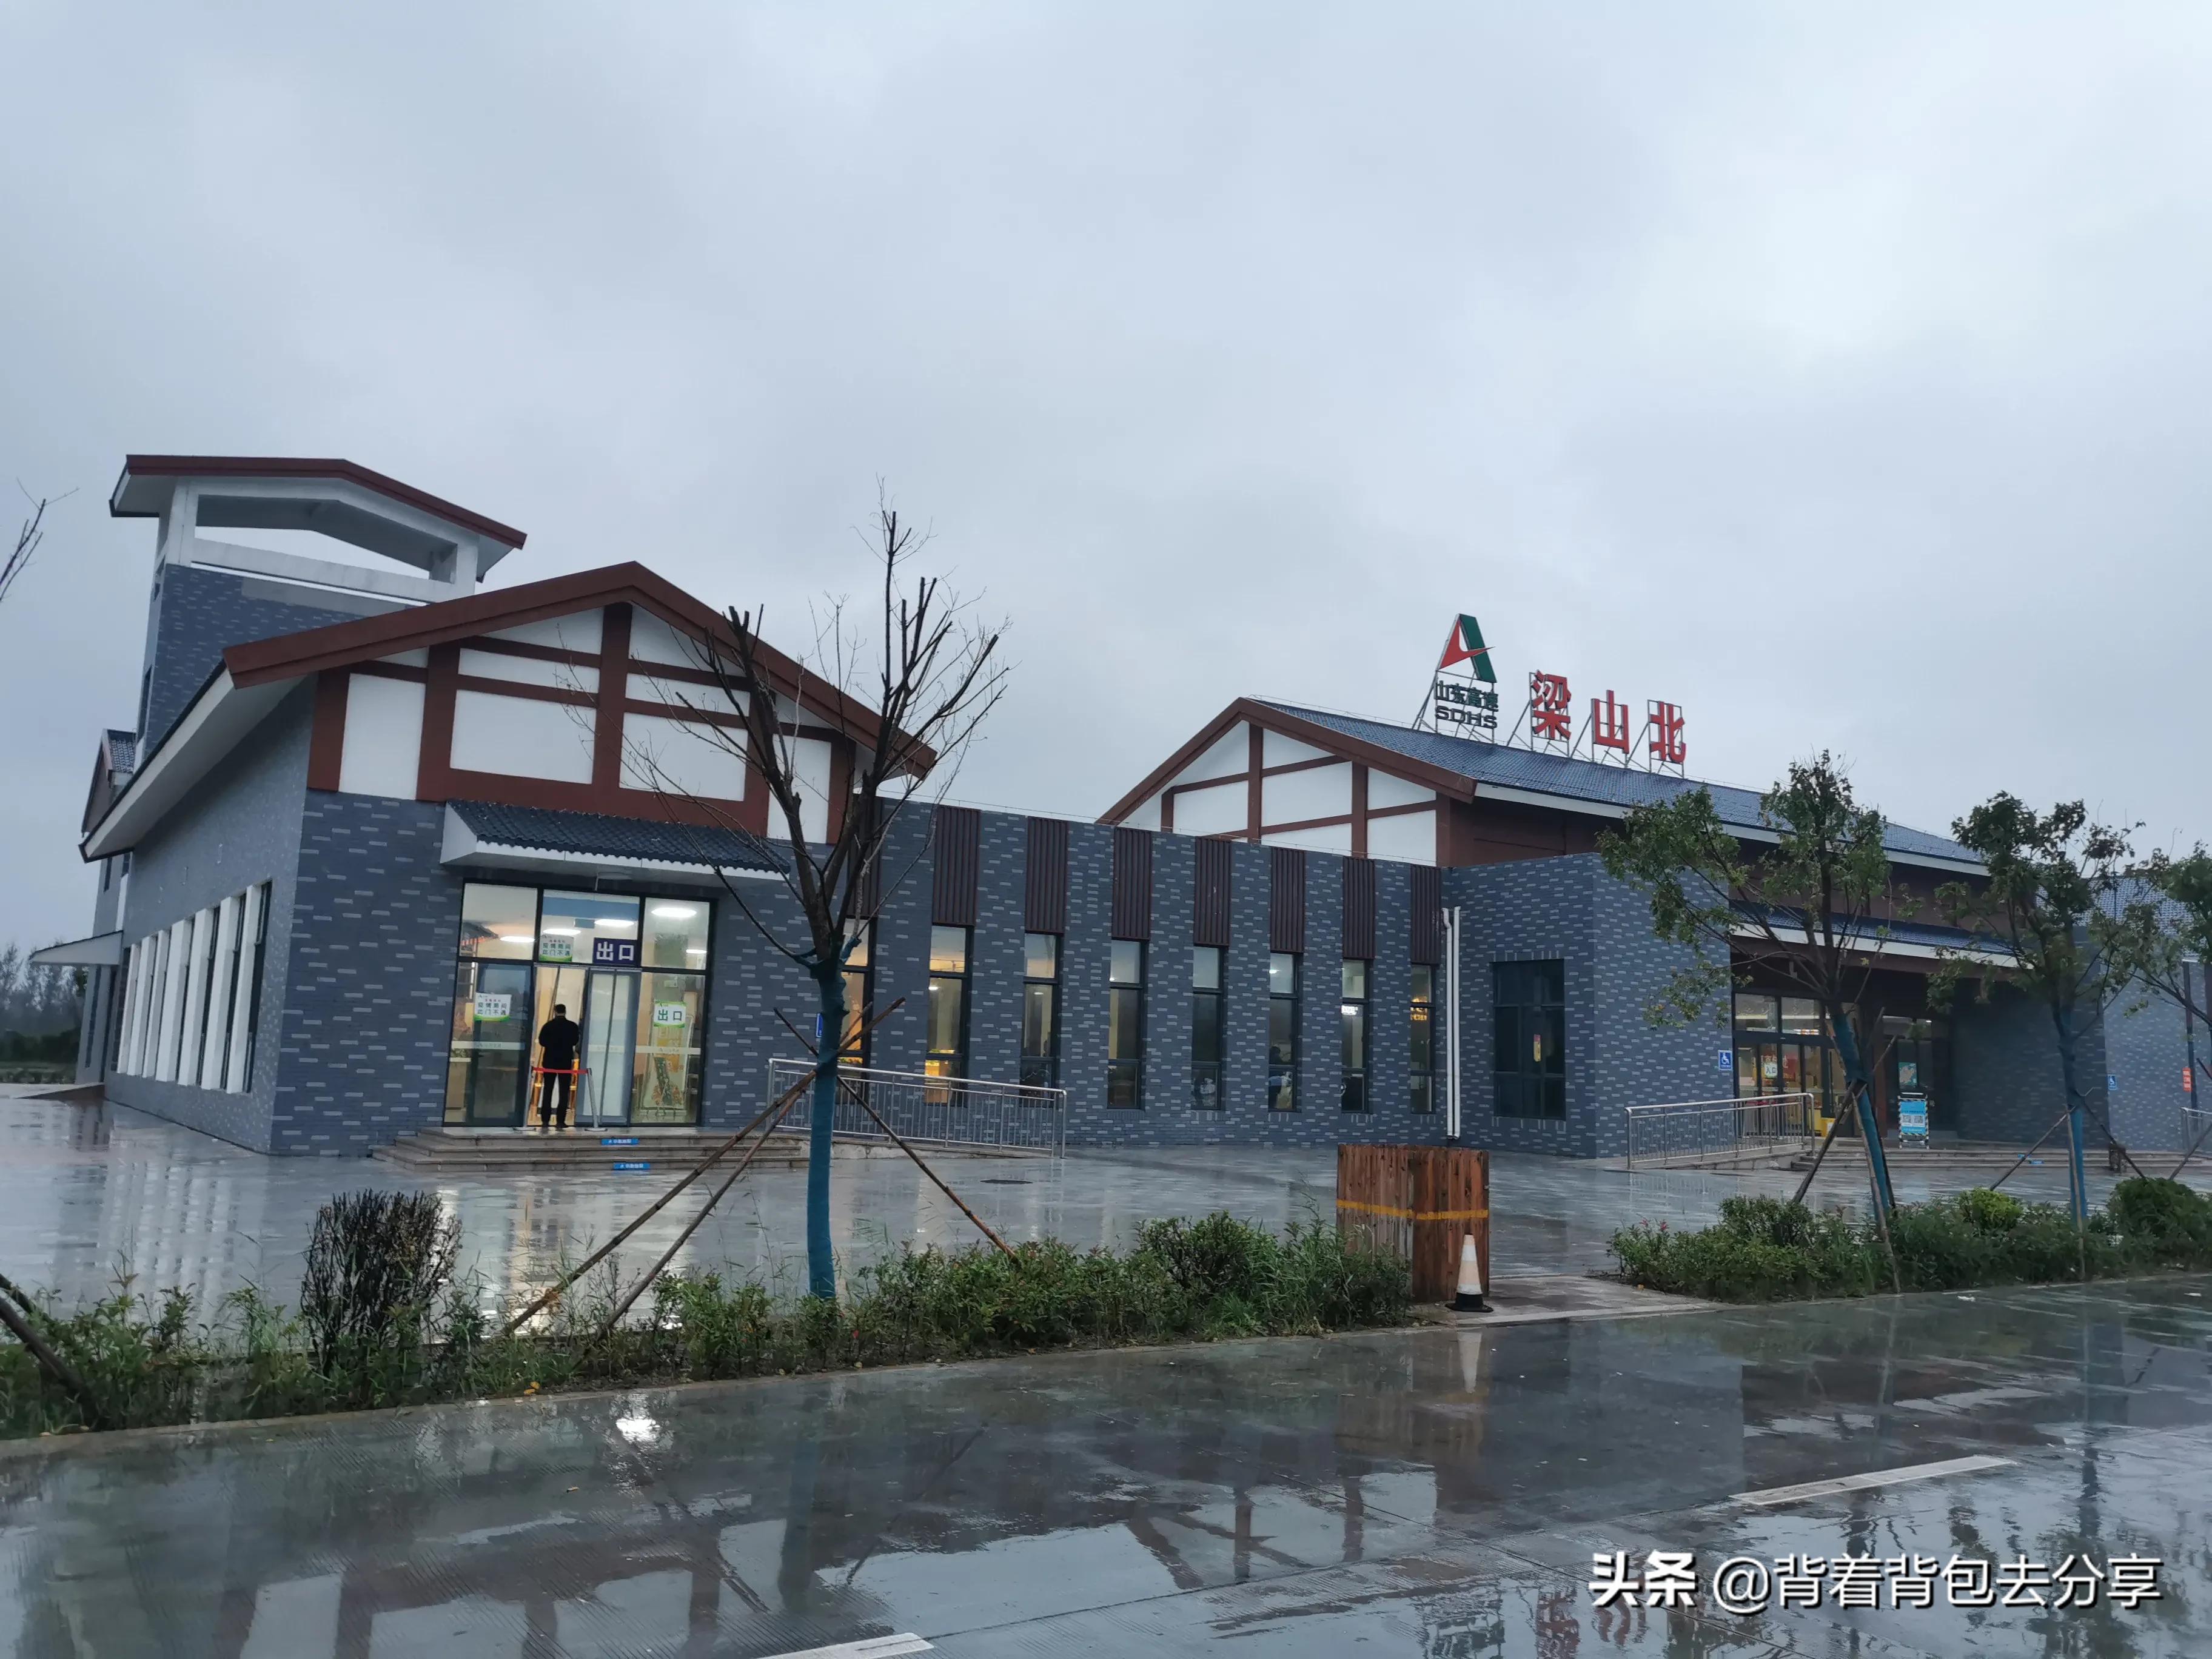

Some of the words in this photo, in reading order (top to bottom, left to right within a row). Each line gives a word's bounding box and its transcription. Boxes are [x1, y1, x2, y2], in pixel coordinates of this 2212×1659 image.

[1434, 680, 1498, 712] 山东高速
[1435, 705, 1497, 729] SDHS
[1530, 669, 1686, 764] 梁山北
[596, 941, 634, 960] 出口
[658, 1008, 682, 1021] 出口
